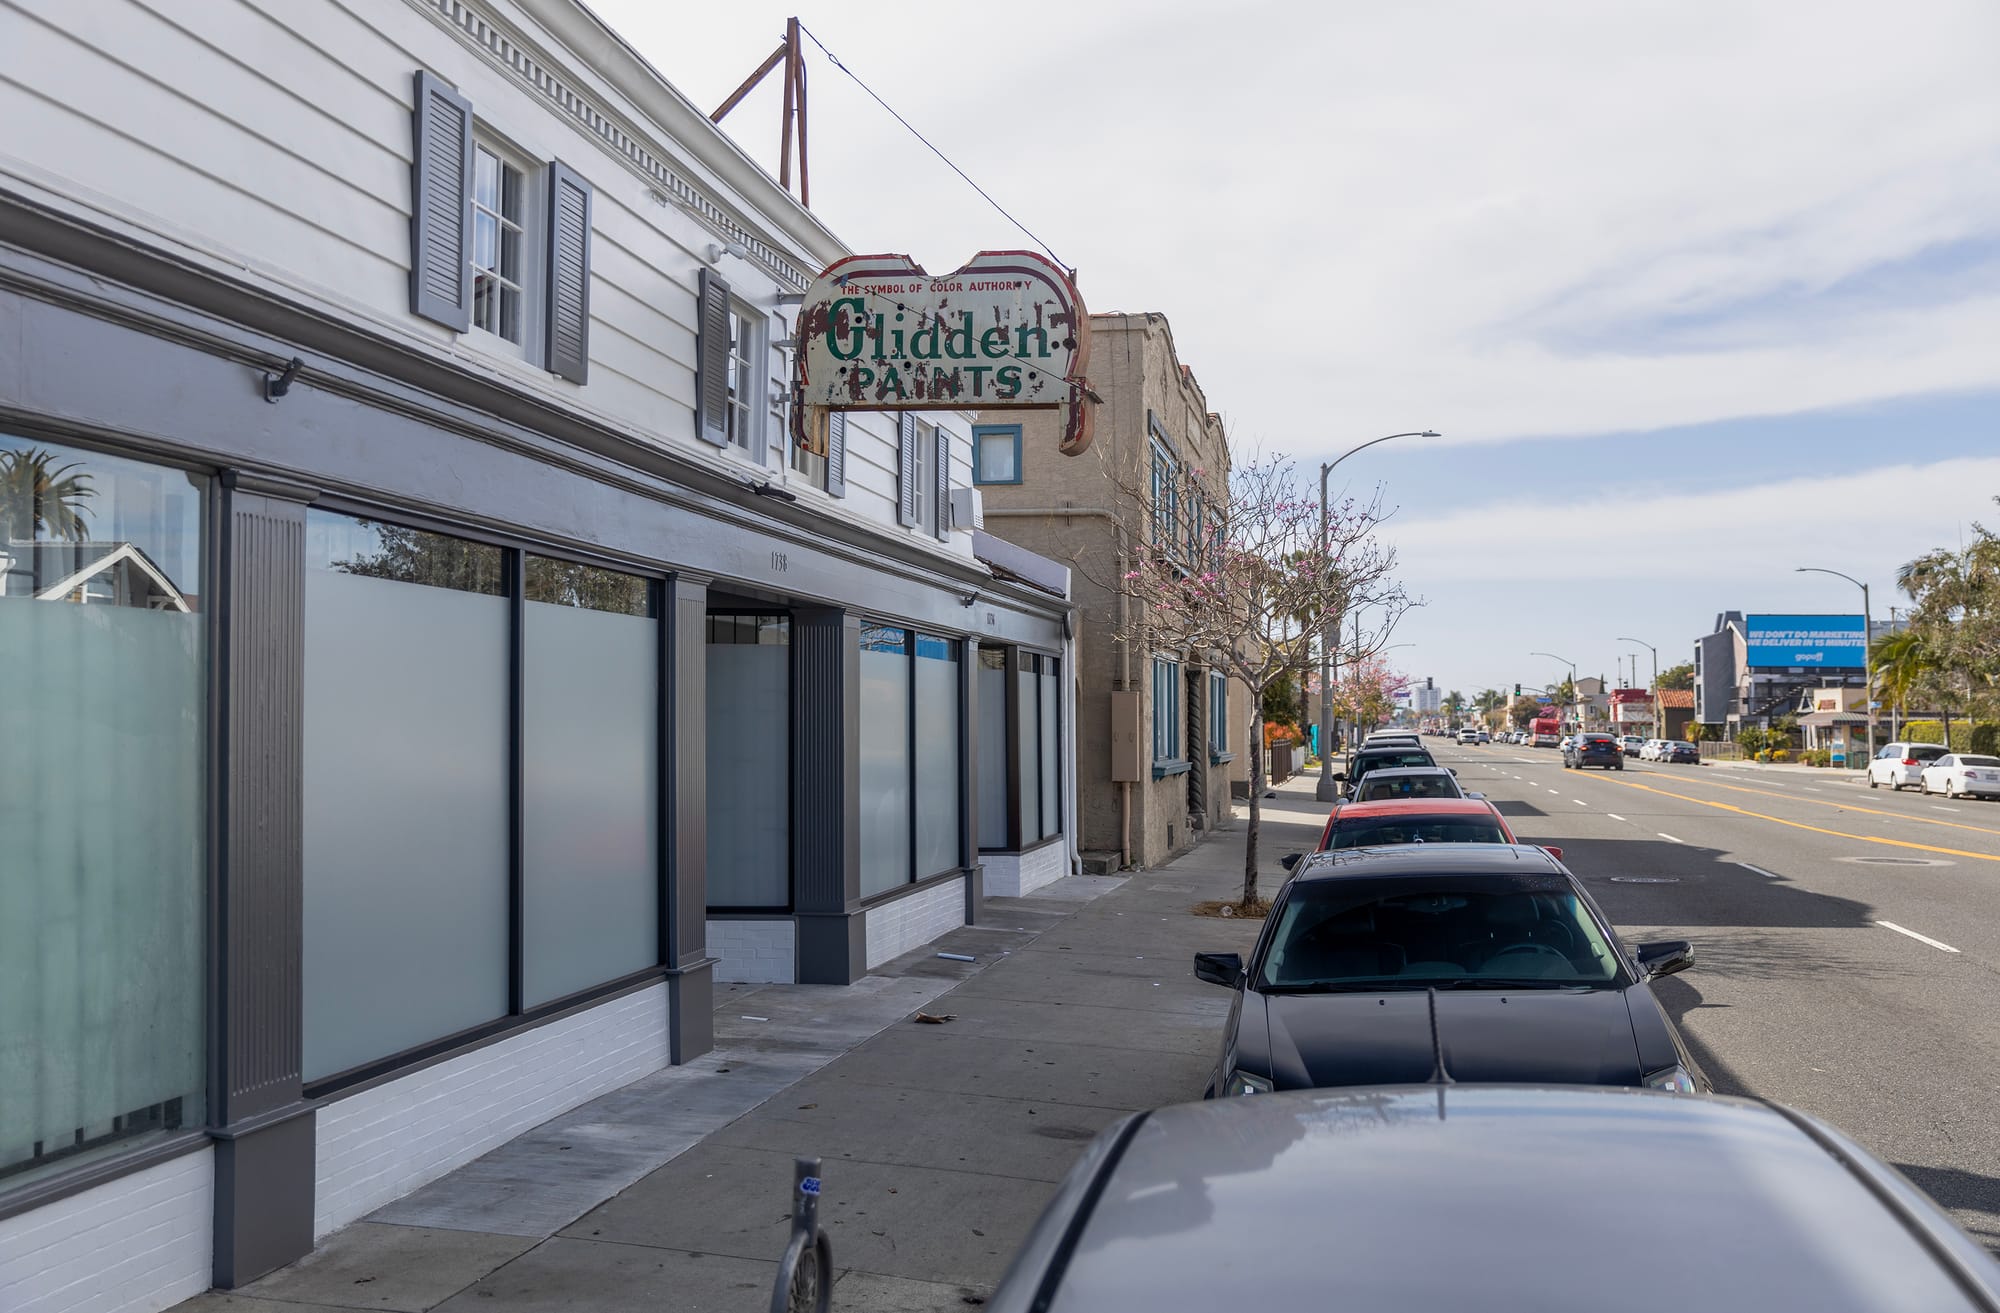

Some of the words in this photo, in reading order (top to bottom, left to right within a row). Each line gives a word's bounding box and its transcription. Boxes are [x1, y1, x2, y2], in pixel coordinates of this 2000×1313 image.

[841, 286, 860, 295] THE
[864, 284, 905, 295] SYMBOL
[909, 283, 922, 293] OF
[929, 282, 963, 293] COLOR
[826, 297, 1052, 360] Glidden
[849, 365, 1022, 400] PAINTS
[1749, 631, 1764, 639] WE
[1765, 631, 1794, 639] DON'T
[1794, 631, 1808, 639] DO
[1748, 639, 1762, 647] WE
[1762, 639, 1802, 647] DELIVER
[1803, 639, 1813, 647] IN
[1795, 652, 1823, 662] gopuff
